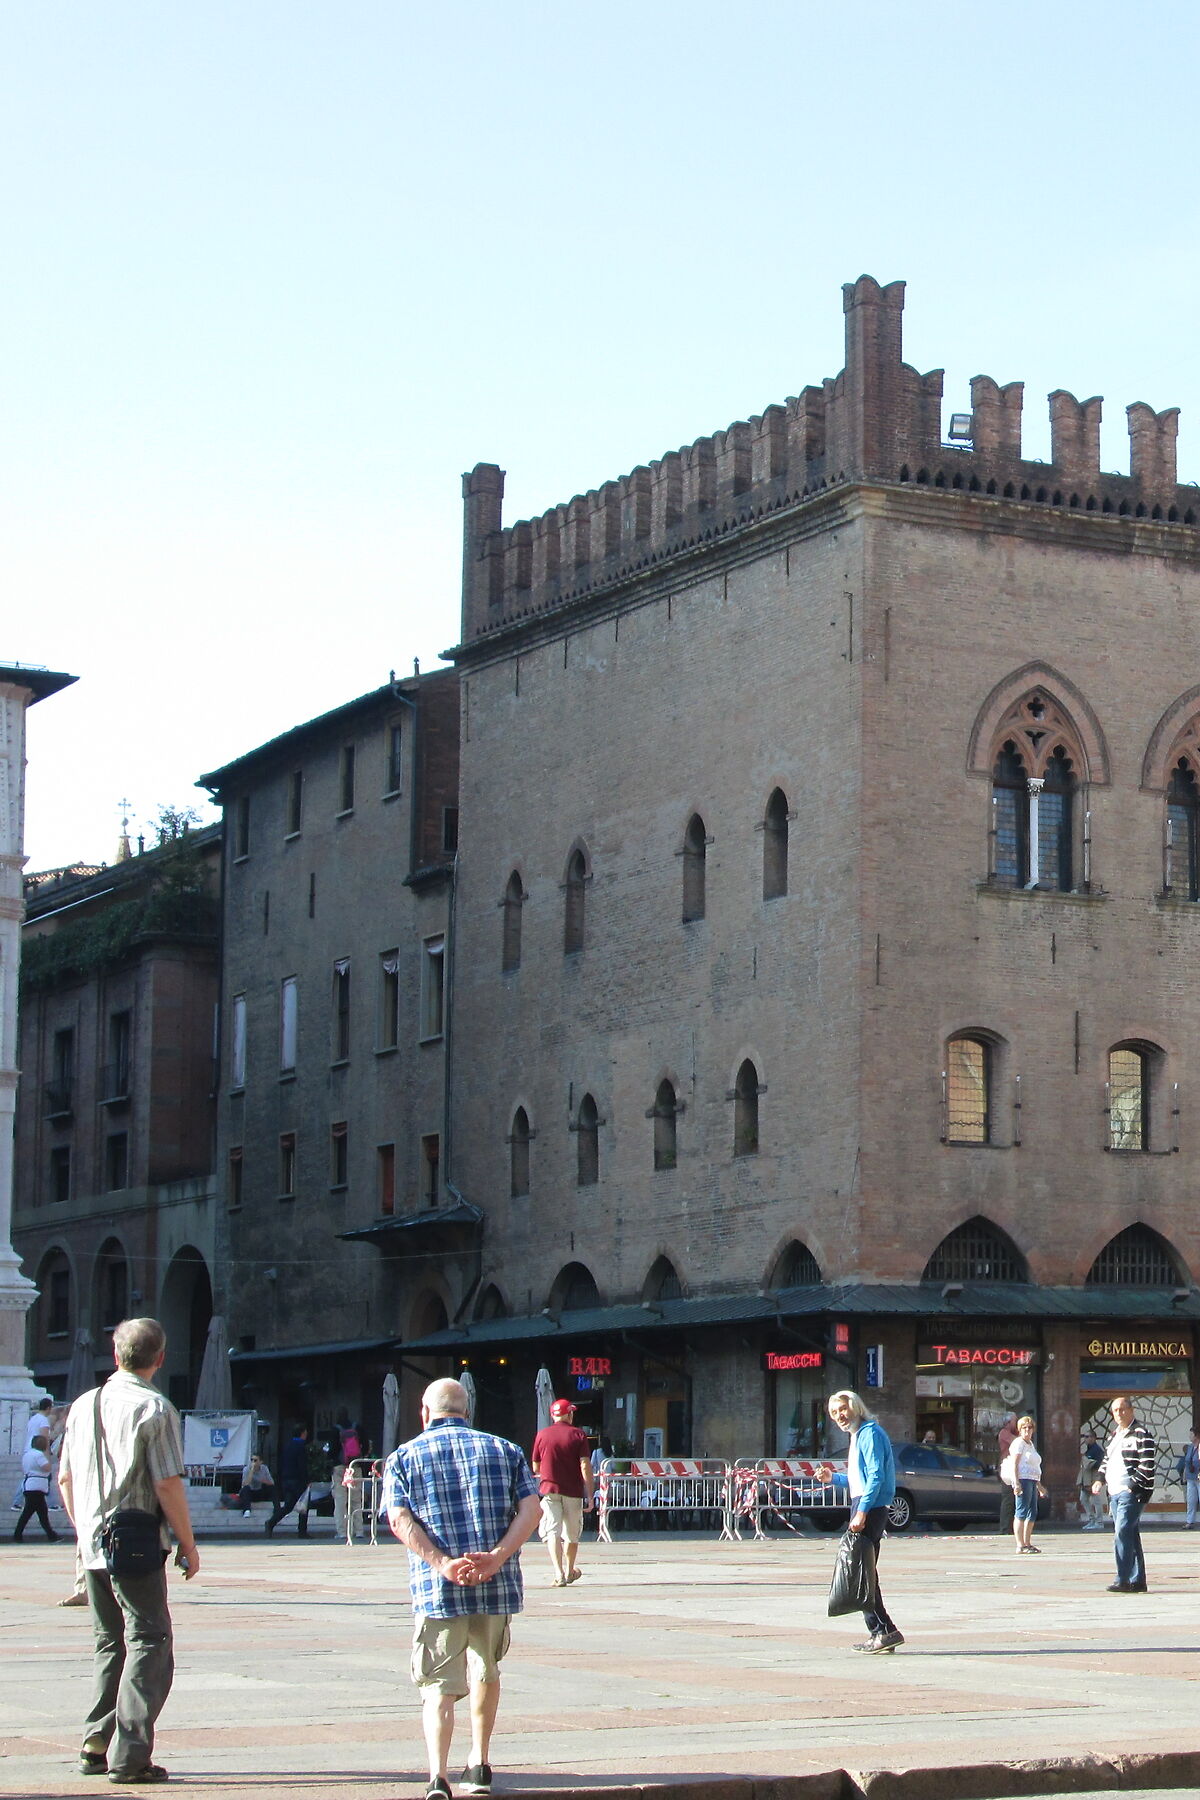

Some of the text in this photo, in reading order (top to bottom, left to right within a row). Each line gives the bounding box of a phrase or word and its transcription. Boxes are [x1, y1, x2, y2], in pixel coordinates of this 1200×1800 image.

[932, 1345, 1030, 1364] TABACCHI
[1103, 1342, 1187, 1356] EMILBANCA
[569, 1357, 612, 1375] BAR
[766, 1352, 822, 1370] TABACCHI
